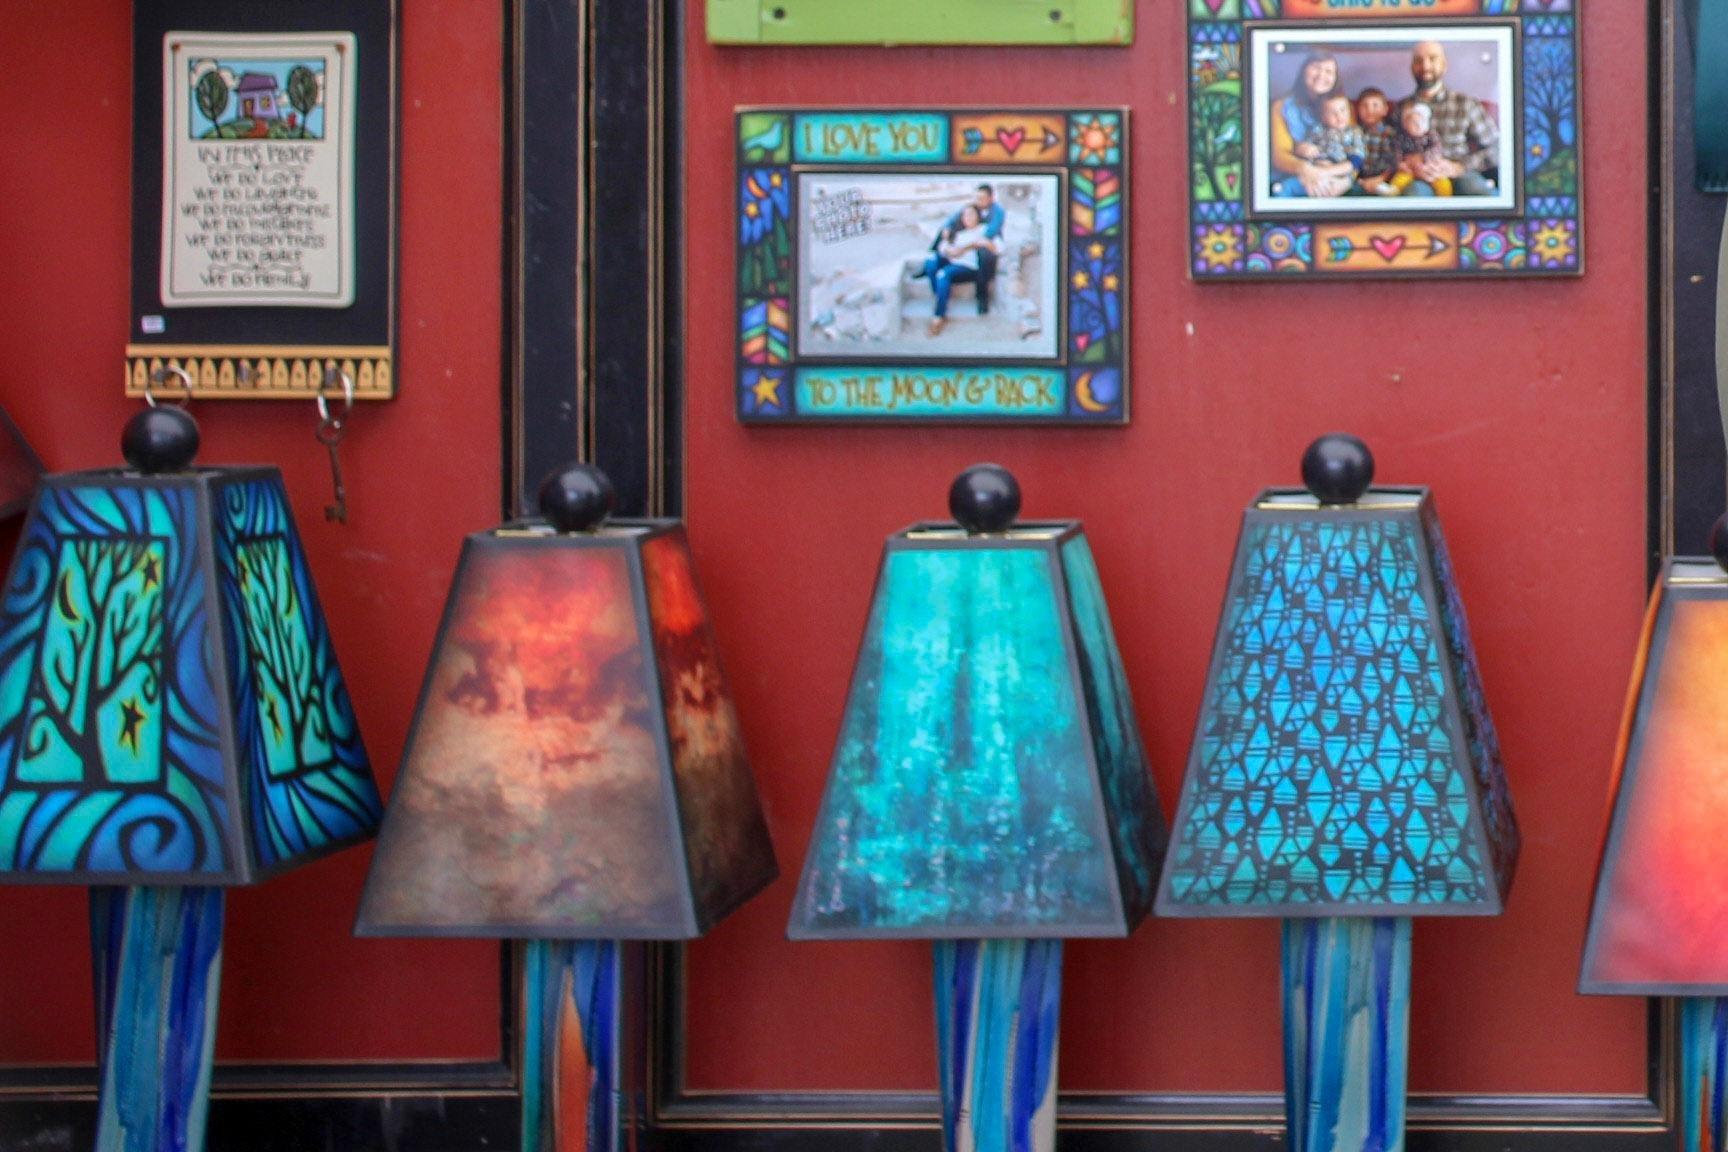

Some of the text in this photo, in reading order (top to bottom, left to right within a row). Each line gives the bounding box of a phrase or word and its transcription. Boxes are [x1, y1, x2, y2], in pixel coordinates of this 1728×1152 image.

[805, 121, 939, 154] I LOVE YOU
[807, 373, 1055, 409] TO THE MOON & BACK
